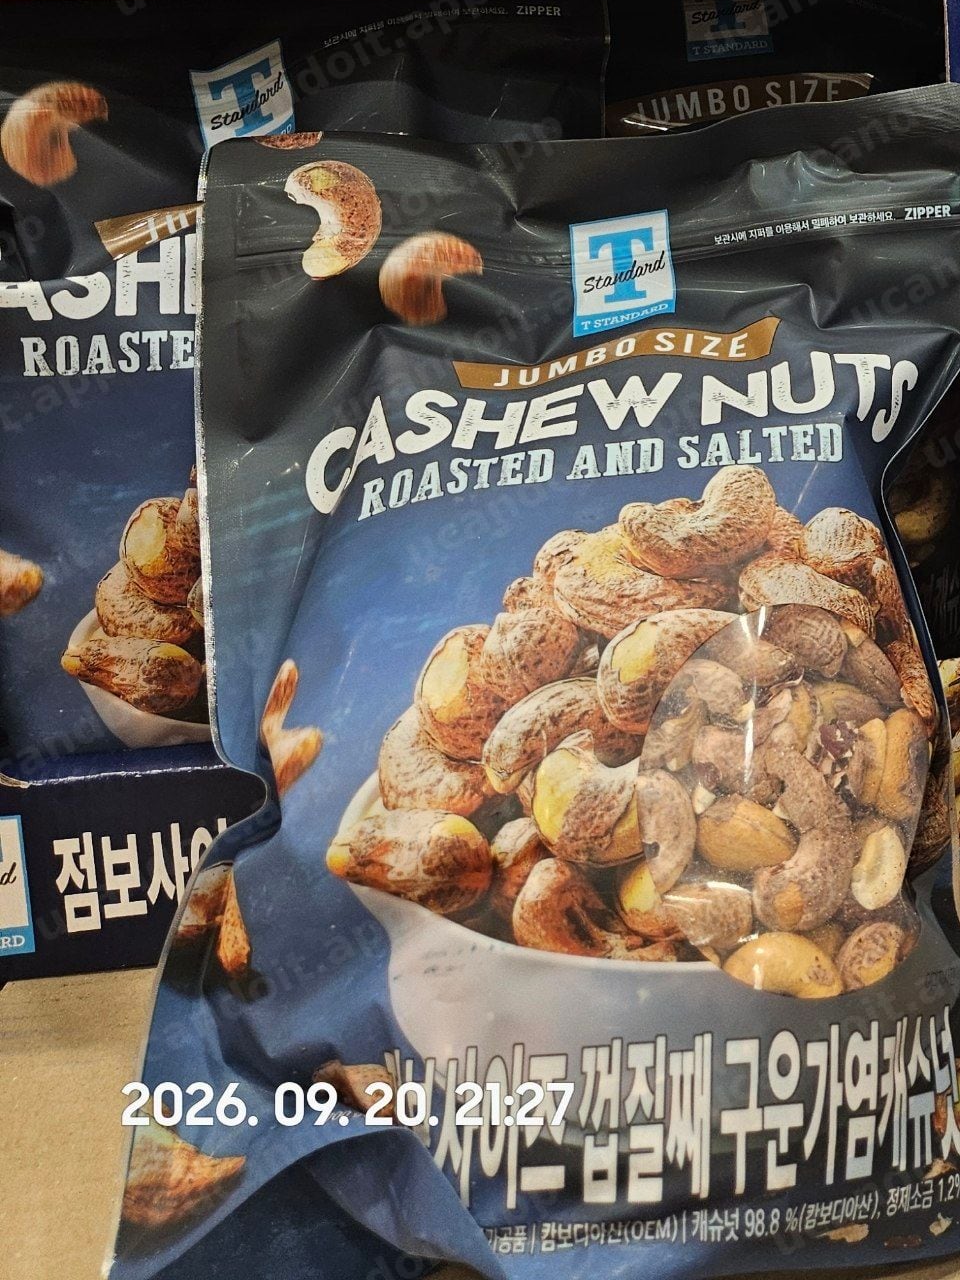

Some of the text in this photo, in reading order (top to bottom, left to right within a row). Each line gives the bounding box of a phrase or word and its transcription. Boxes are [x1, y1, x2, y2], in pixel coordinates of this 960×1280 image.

[516, 5, 561, 17] ZIPPER
[703, 39, 769, 54] STANDARD
[210, 71, 284, 131] Standard
[637, 78, 842, 123] JUMBO SIZE
[714, 228, 747, 246] 보관시에
[748, 226, 774, 240] 지퍼를
[775, 220, 810, 236] 이용해서
[811, 214, 847, 230] 밀폐하여
[904, 204, 952, 221] ZIPPER
[582, 250, 666, 294] Standard
[588, 227, 654, 304] T
[581, 303, 669, 331] T STANDARD
[492, 331, 749, 388] JUMBO SIZE
[305, 350, 919, 515] CASHEW NUTS
[357, 422, 844, 521] ROASTED AND SALTED
[578, 1031, 713, 1203] 껍질째
[541, 1214, 678, 1252] 캄보디아산(OEM)
[692, 1207, 740, 1242] 캐슈넛
[744, 1207, 781, 1238] 98.8
[886, 1179, 935, 1218] 정제소금
